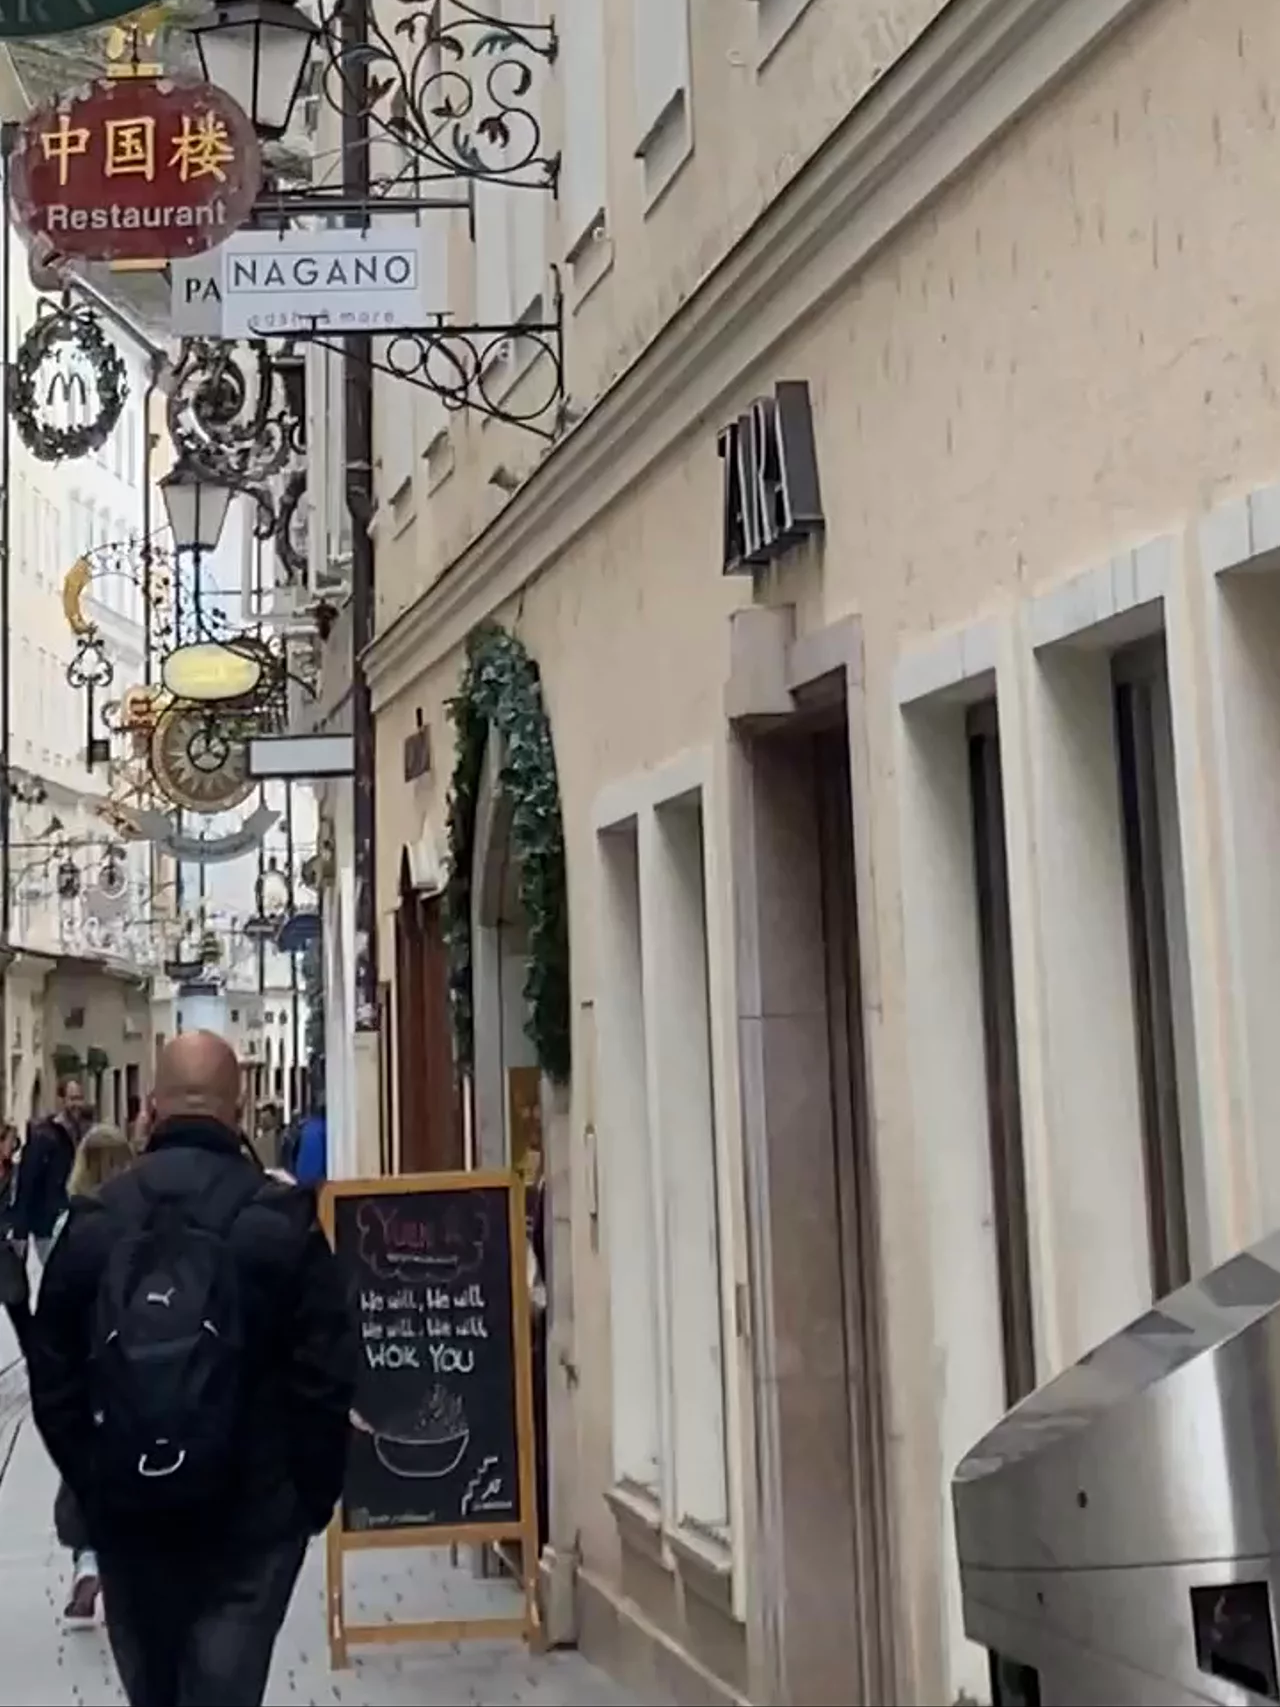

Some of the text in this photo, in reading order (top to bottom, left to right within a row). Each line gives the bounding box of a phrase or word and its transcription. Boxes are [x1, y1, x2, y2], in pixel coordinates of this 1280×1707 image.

[40, 114, 236, 185] 中国楼
[46, 200, 227, 232] Restaurant
[233, 255, 412, 287] NAGANO
[365, 1343, 474, 1373] WOK YOU
